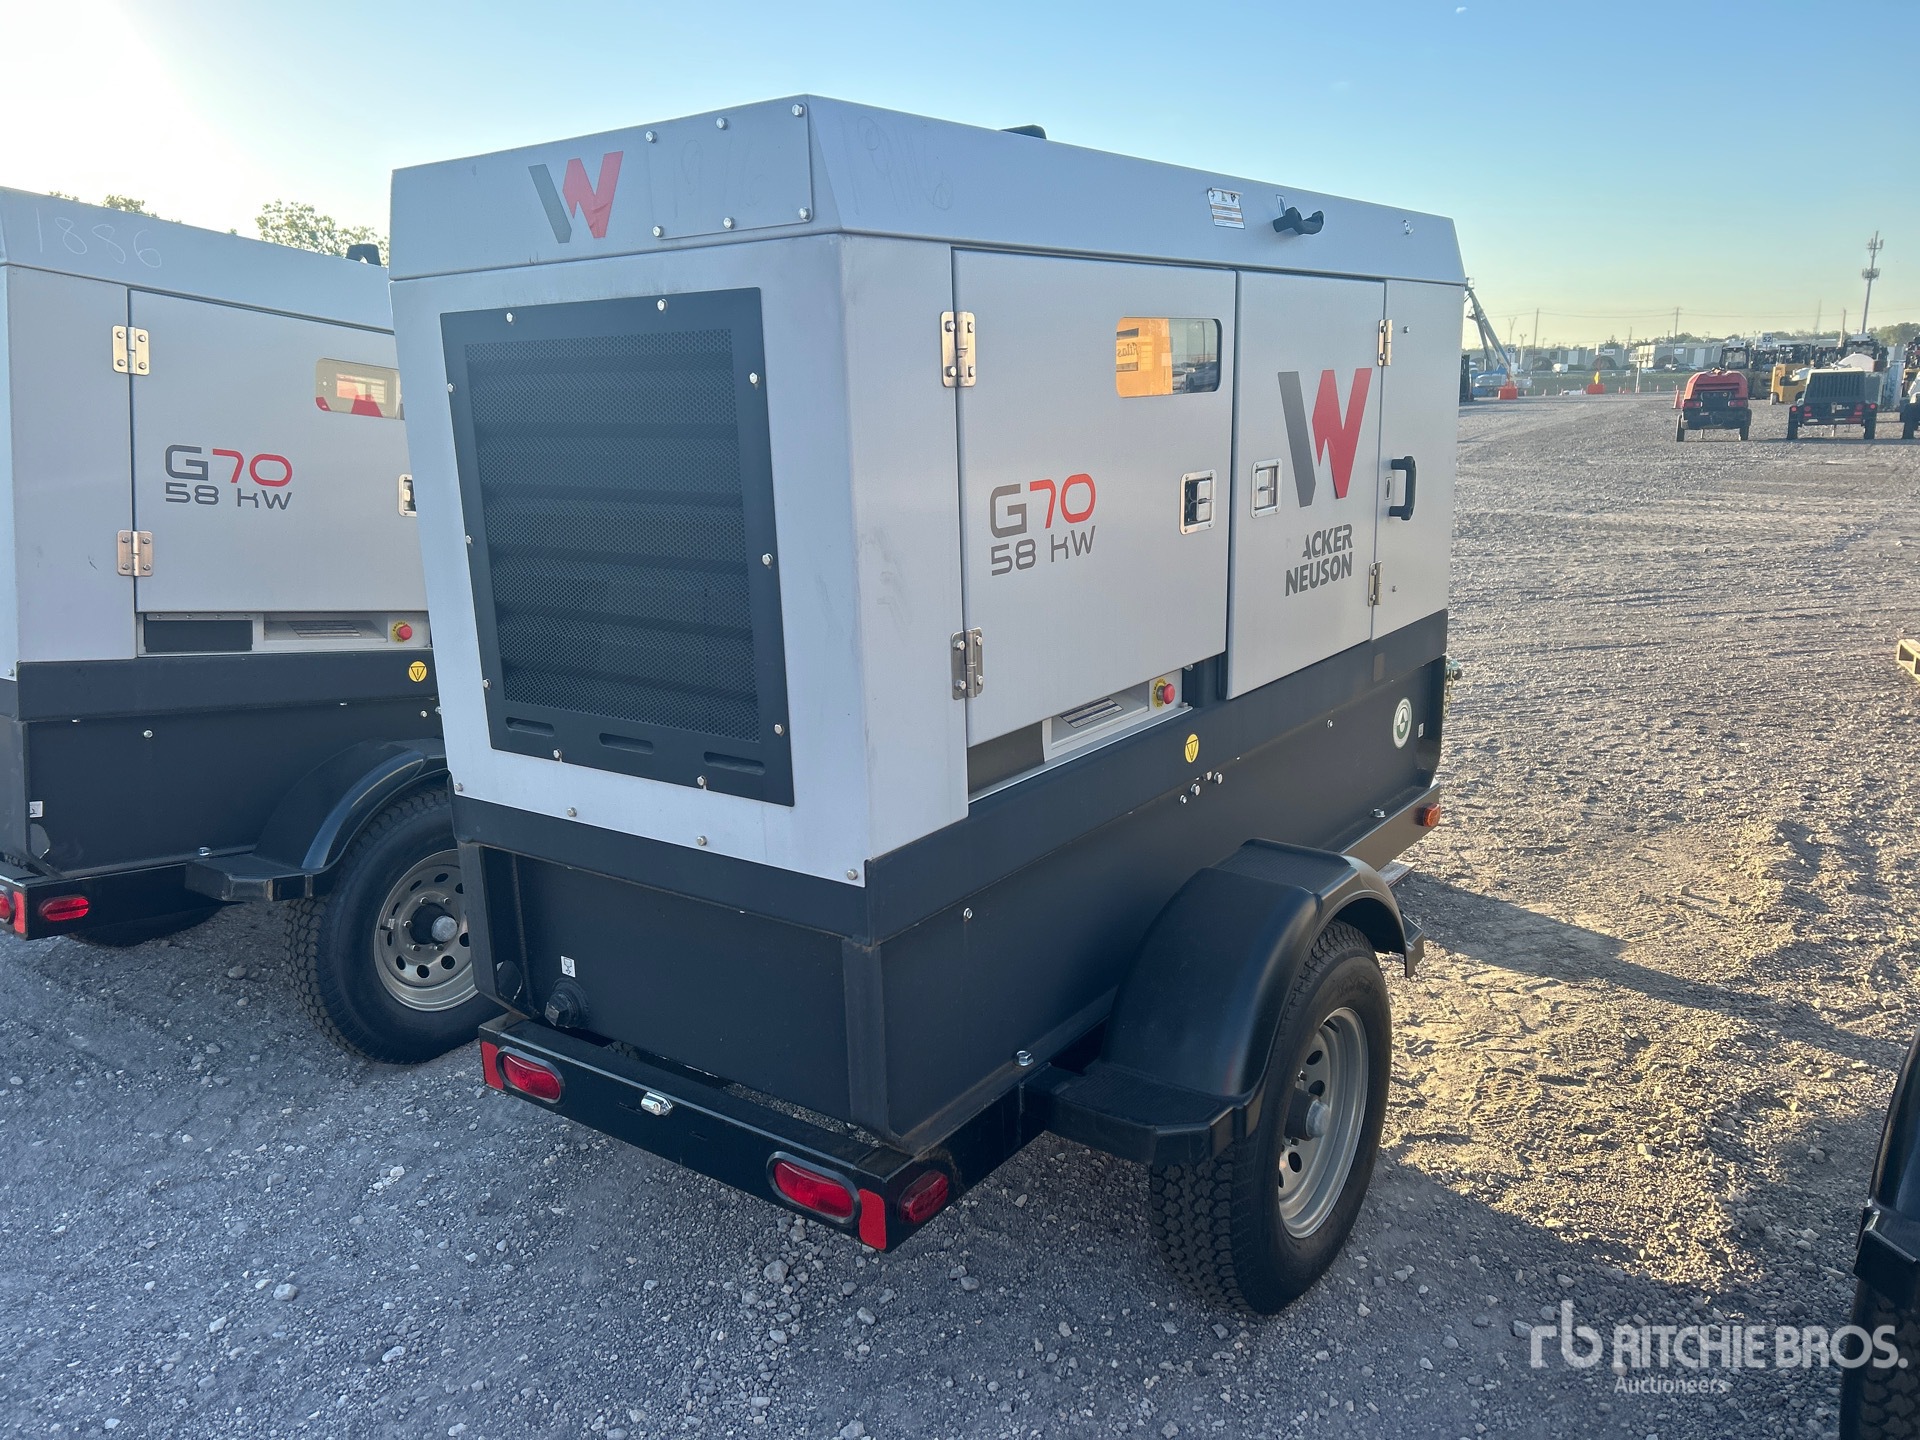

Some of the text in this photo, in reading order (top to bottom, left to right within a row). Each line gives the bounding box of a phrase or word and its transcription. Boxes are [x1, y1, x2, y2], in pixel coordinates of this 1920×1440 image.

[35, 207, 162, 268] 1886
[165, 444, 293, 487] G70
[165, 482, 219, 505] 58
[989, 473, 1097, 539] G70
[990, 538, 1037, 576] 58
[1302, 523, 1353, 560] ACKER
[1285, 551, 1353, 597] NEUSON
